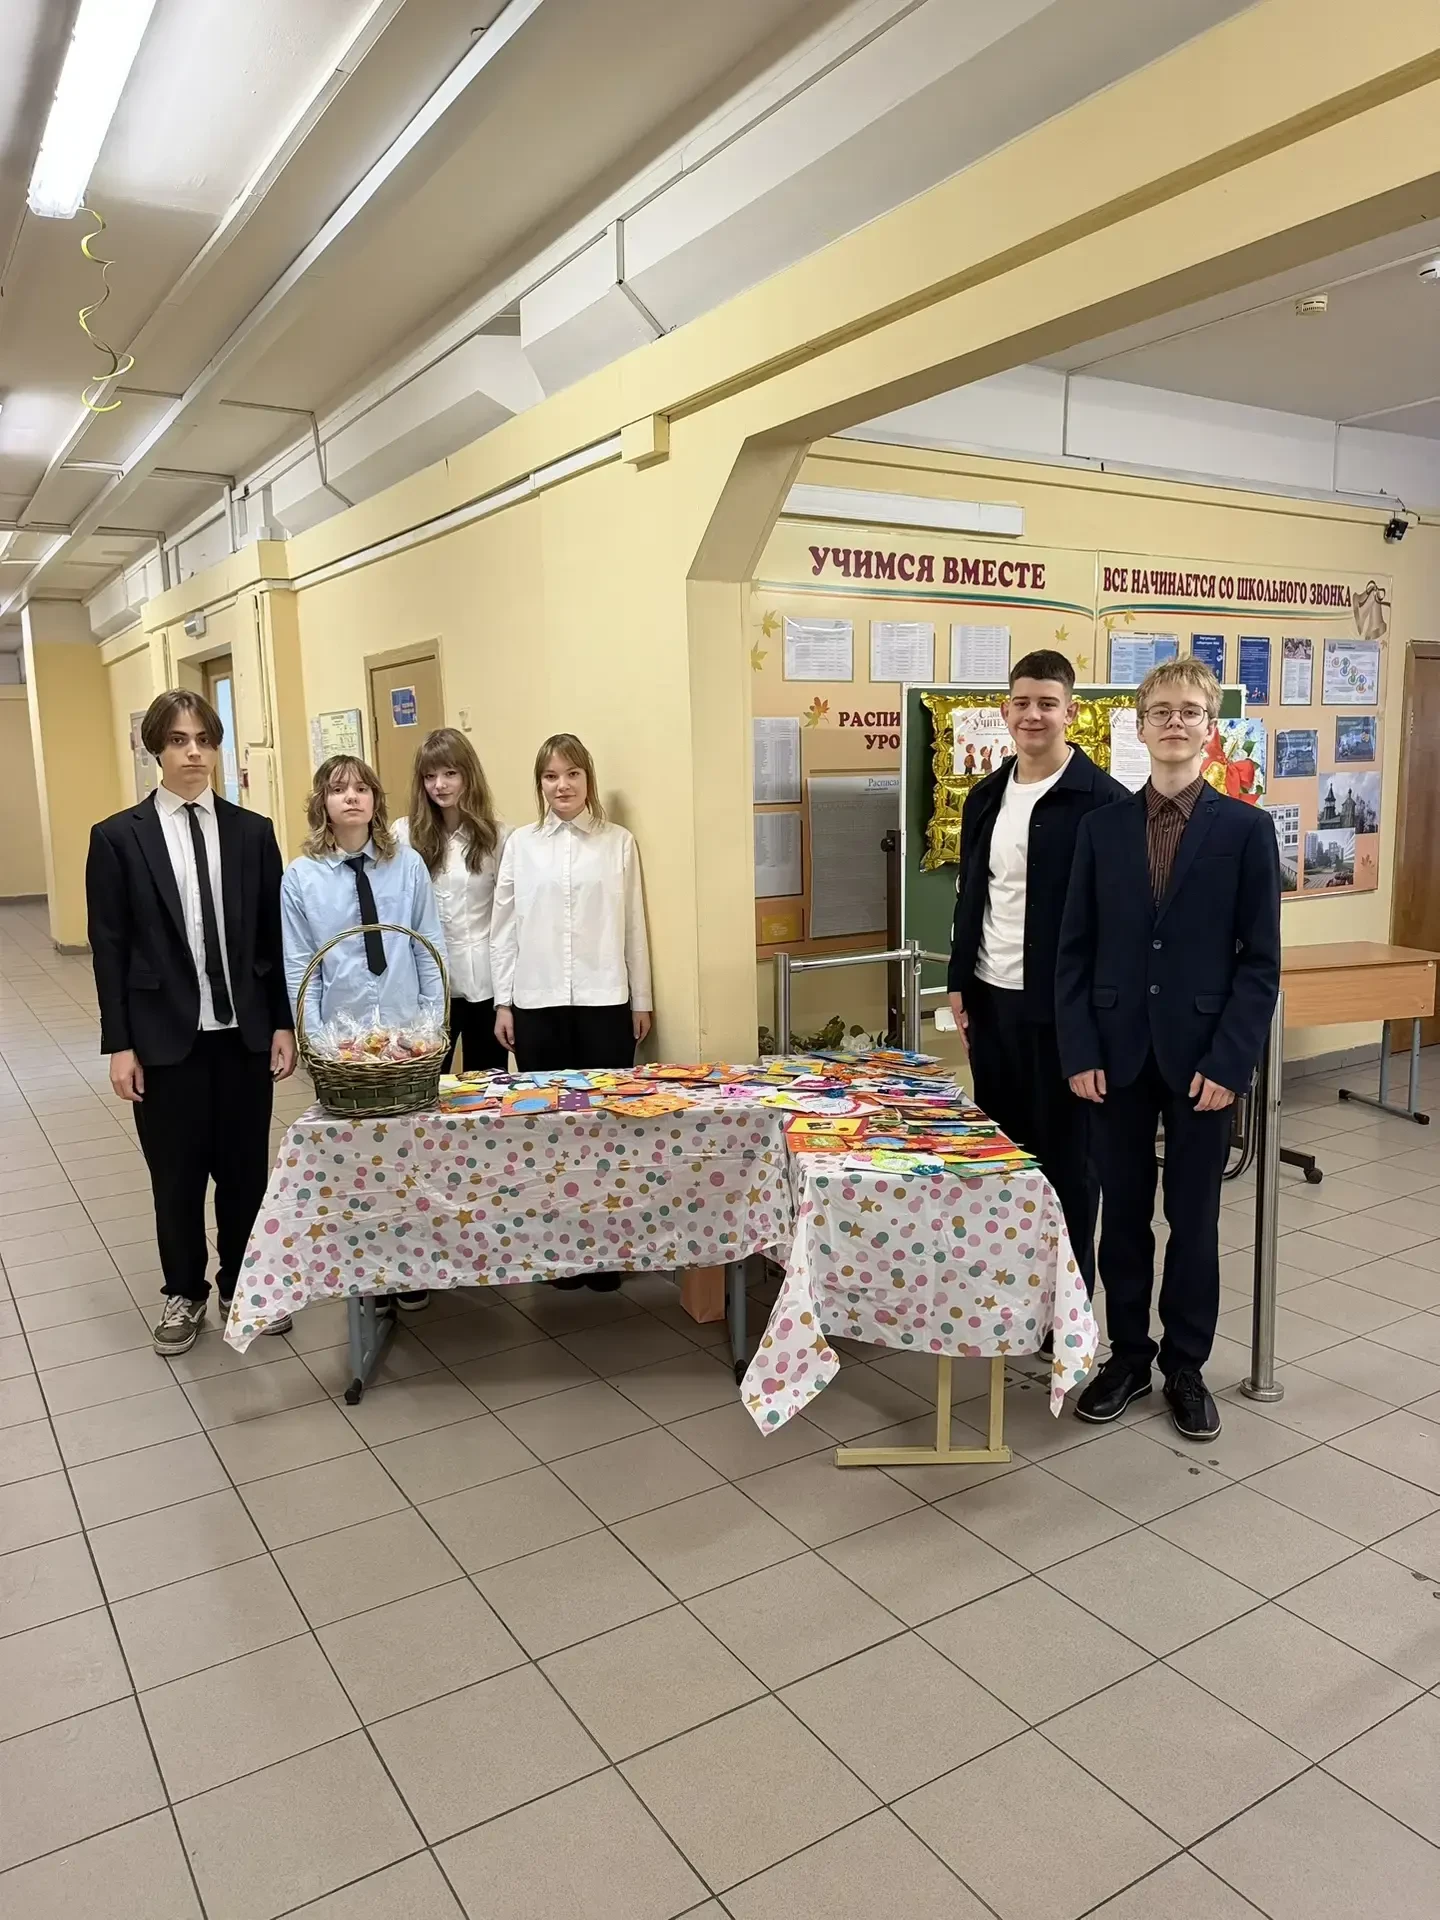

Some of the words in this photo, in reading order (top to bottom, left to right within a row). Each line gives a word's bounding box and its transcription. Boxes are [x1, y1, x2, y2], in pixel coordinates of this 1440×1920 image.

[808, 546, 935, 582] УЧИМСЯ
[942, 556, 1046, 590] ВМЕСТЕ
[1103, 567, 1128, 592] ВСЕ
[1131, 569, 1216, 599] НАЧИНАЕТСЯ
[1219, 575, 1233, 600] СО
[1236, 577, 1307, 604] ШКОЛЬНОГО
[1309, 582, 1352, 608] ЗВОНКА
[838, 711, 901, 727] РАСПИ
[864, 734, 901, 750] УРО
